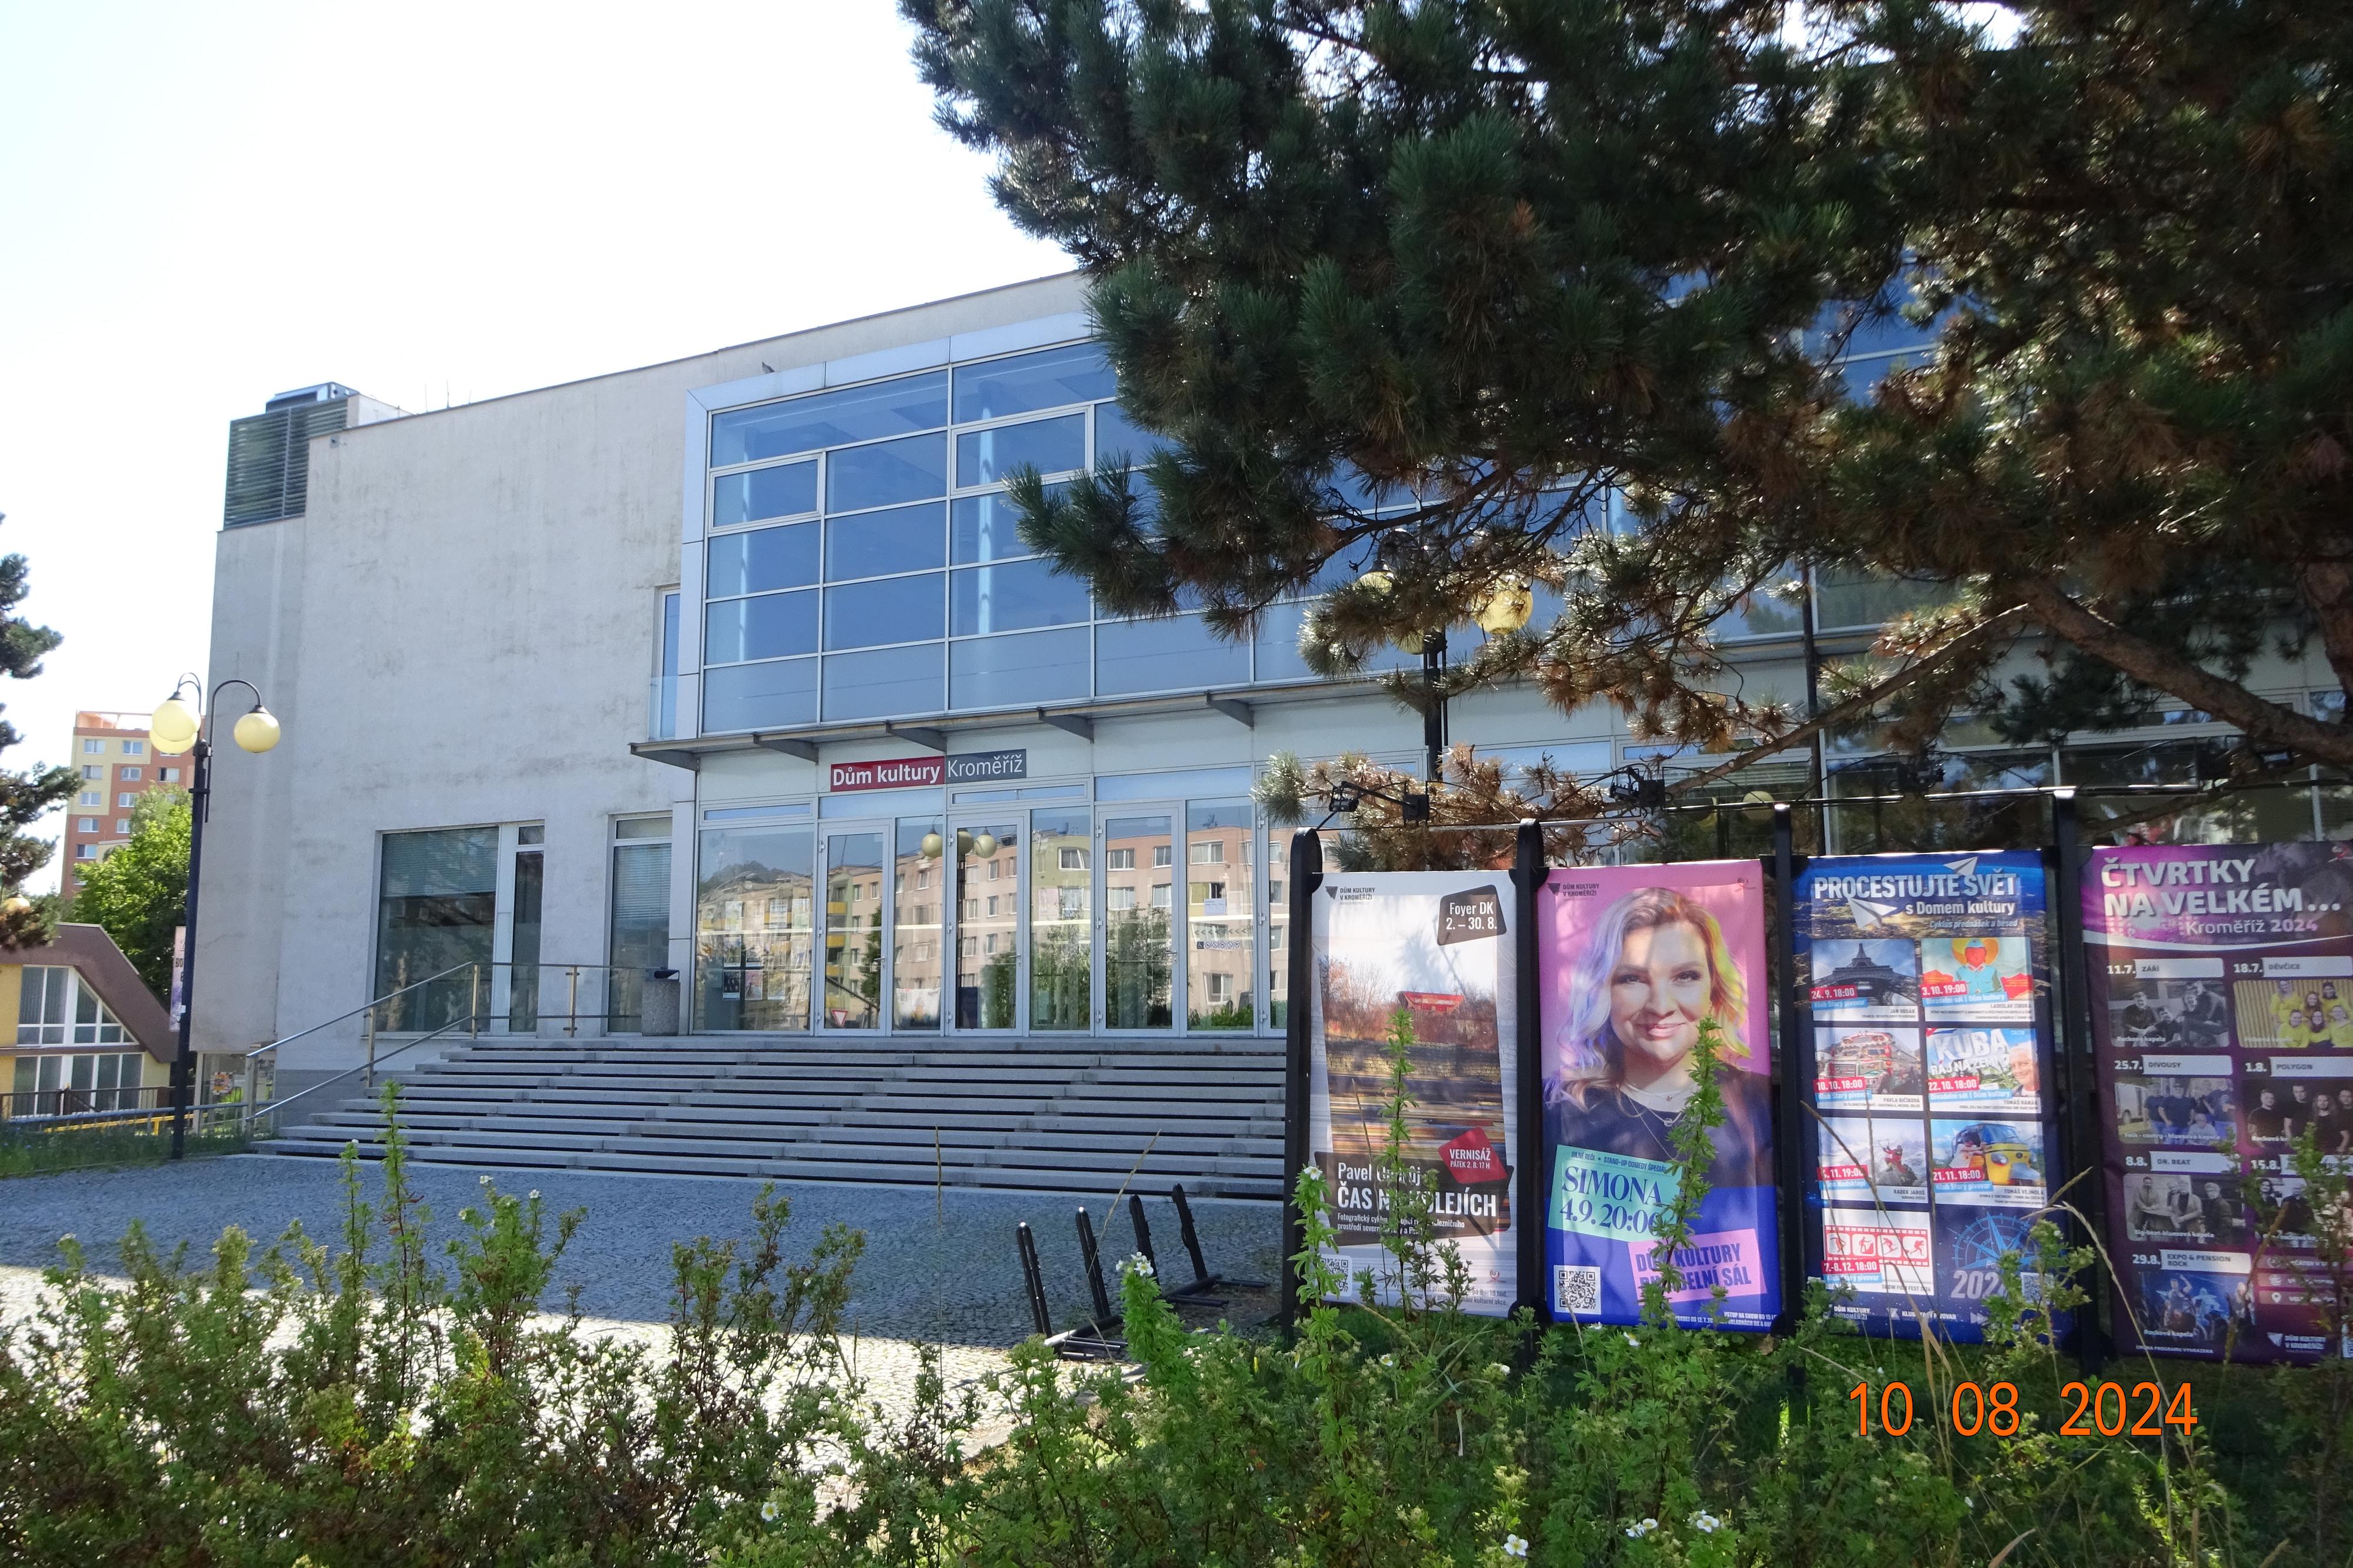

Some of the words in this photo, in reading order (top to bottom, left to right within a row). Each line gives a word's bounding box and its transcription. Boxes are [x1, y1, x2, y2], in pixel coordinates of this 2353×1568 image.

[833, 766, 872, 786] Dům
[877, 764, 941, 785] kultury
[948, 754, 1023, 778] Kroměříž
[2101, 856, 2255, 888] ČTVRTKY
[1814, 873, 1960, 899] PROCESTUJTE
[1963, 868, 2017, 896] SVĚT
[1449, 902, 1477, 916] Foyer
[1479, 902, 1494, 915] DK
[1905, 905, 1914, 915] s
[1916, 901, 1965, 915] Domem
[1968, 900, 2015, 916] kultury
[2104, 892, 2156, 917] NA
[1446, 918, 1456, 930] 2.
[1468, 917, 1485, 930] 30.
[1487, 916, 1497, 929] 8.
[1929, 920, 1952, 929] Cyklus
[2185, 919, 2265, 935] Kroměříž
[2271, 919, 2318, 933] 2024
[1834, 987, 1855, 997] 18:00
[1944, 983, 1966, 993] 19:00
[1934, 1029, 2010, 1061] KUBA
[1931, 1060, 1954, 1076] RÁJ
[1954, 1060, 1971, 1072] NA
[2114, 1060, 2143, 1070] 25.7.
[1841, 1079, 1863, 1089] 18:00
[1954, 1079, 1977, 1089] 18:00
[1449, 1147, 1491, 1161] VERNISÁŽ
[2125, 1156, 2148, 1166] 8.8.
[1338, 1162, 1372, 1181] Pavel
[1958, 1169, 1981, 1179] 18:00
[1562, 1166, 1664, 1207] SIMONA
[1337, 1180, 1372, 1210] ČAS
[1337, 1213, 1369, 1223] Fotografický
[1635, 1247, 1668, 1272] DŮ
[1673, 1243, 1740, 1267] KULTURY
[2132, 1254, 2161, 1265] 29.8.
[1856, 1261, 1877, 1271] 18:00
[1721, 1263, 1752, 1286] SÁL
[1950, 1269, 2007, 1301] 202
